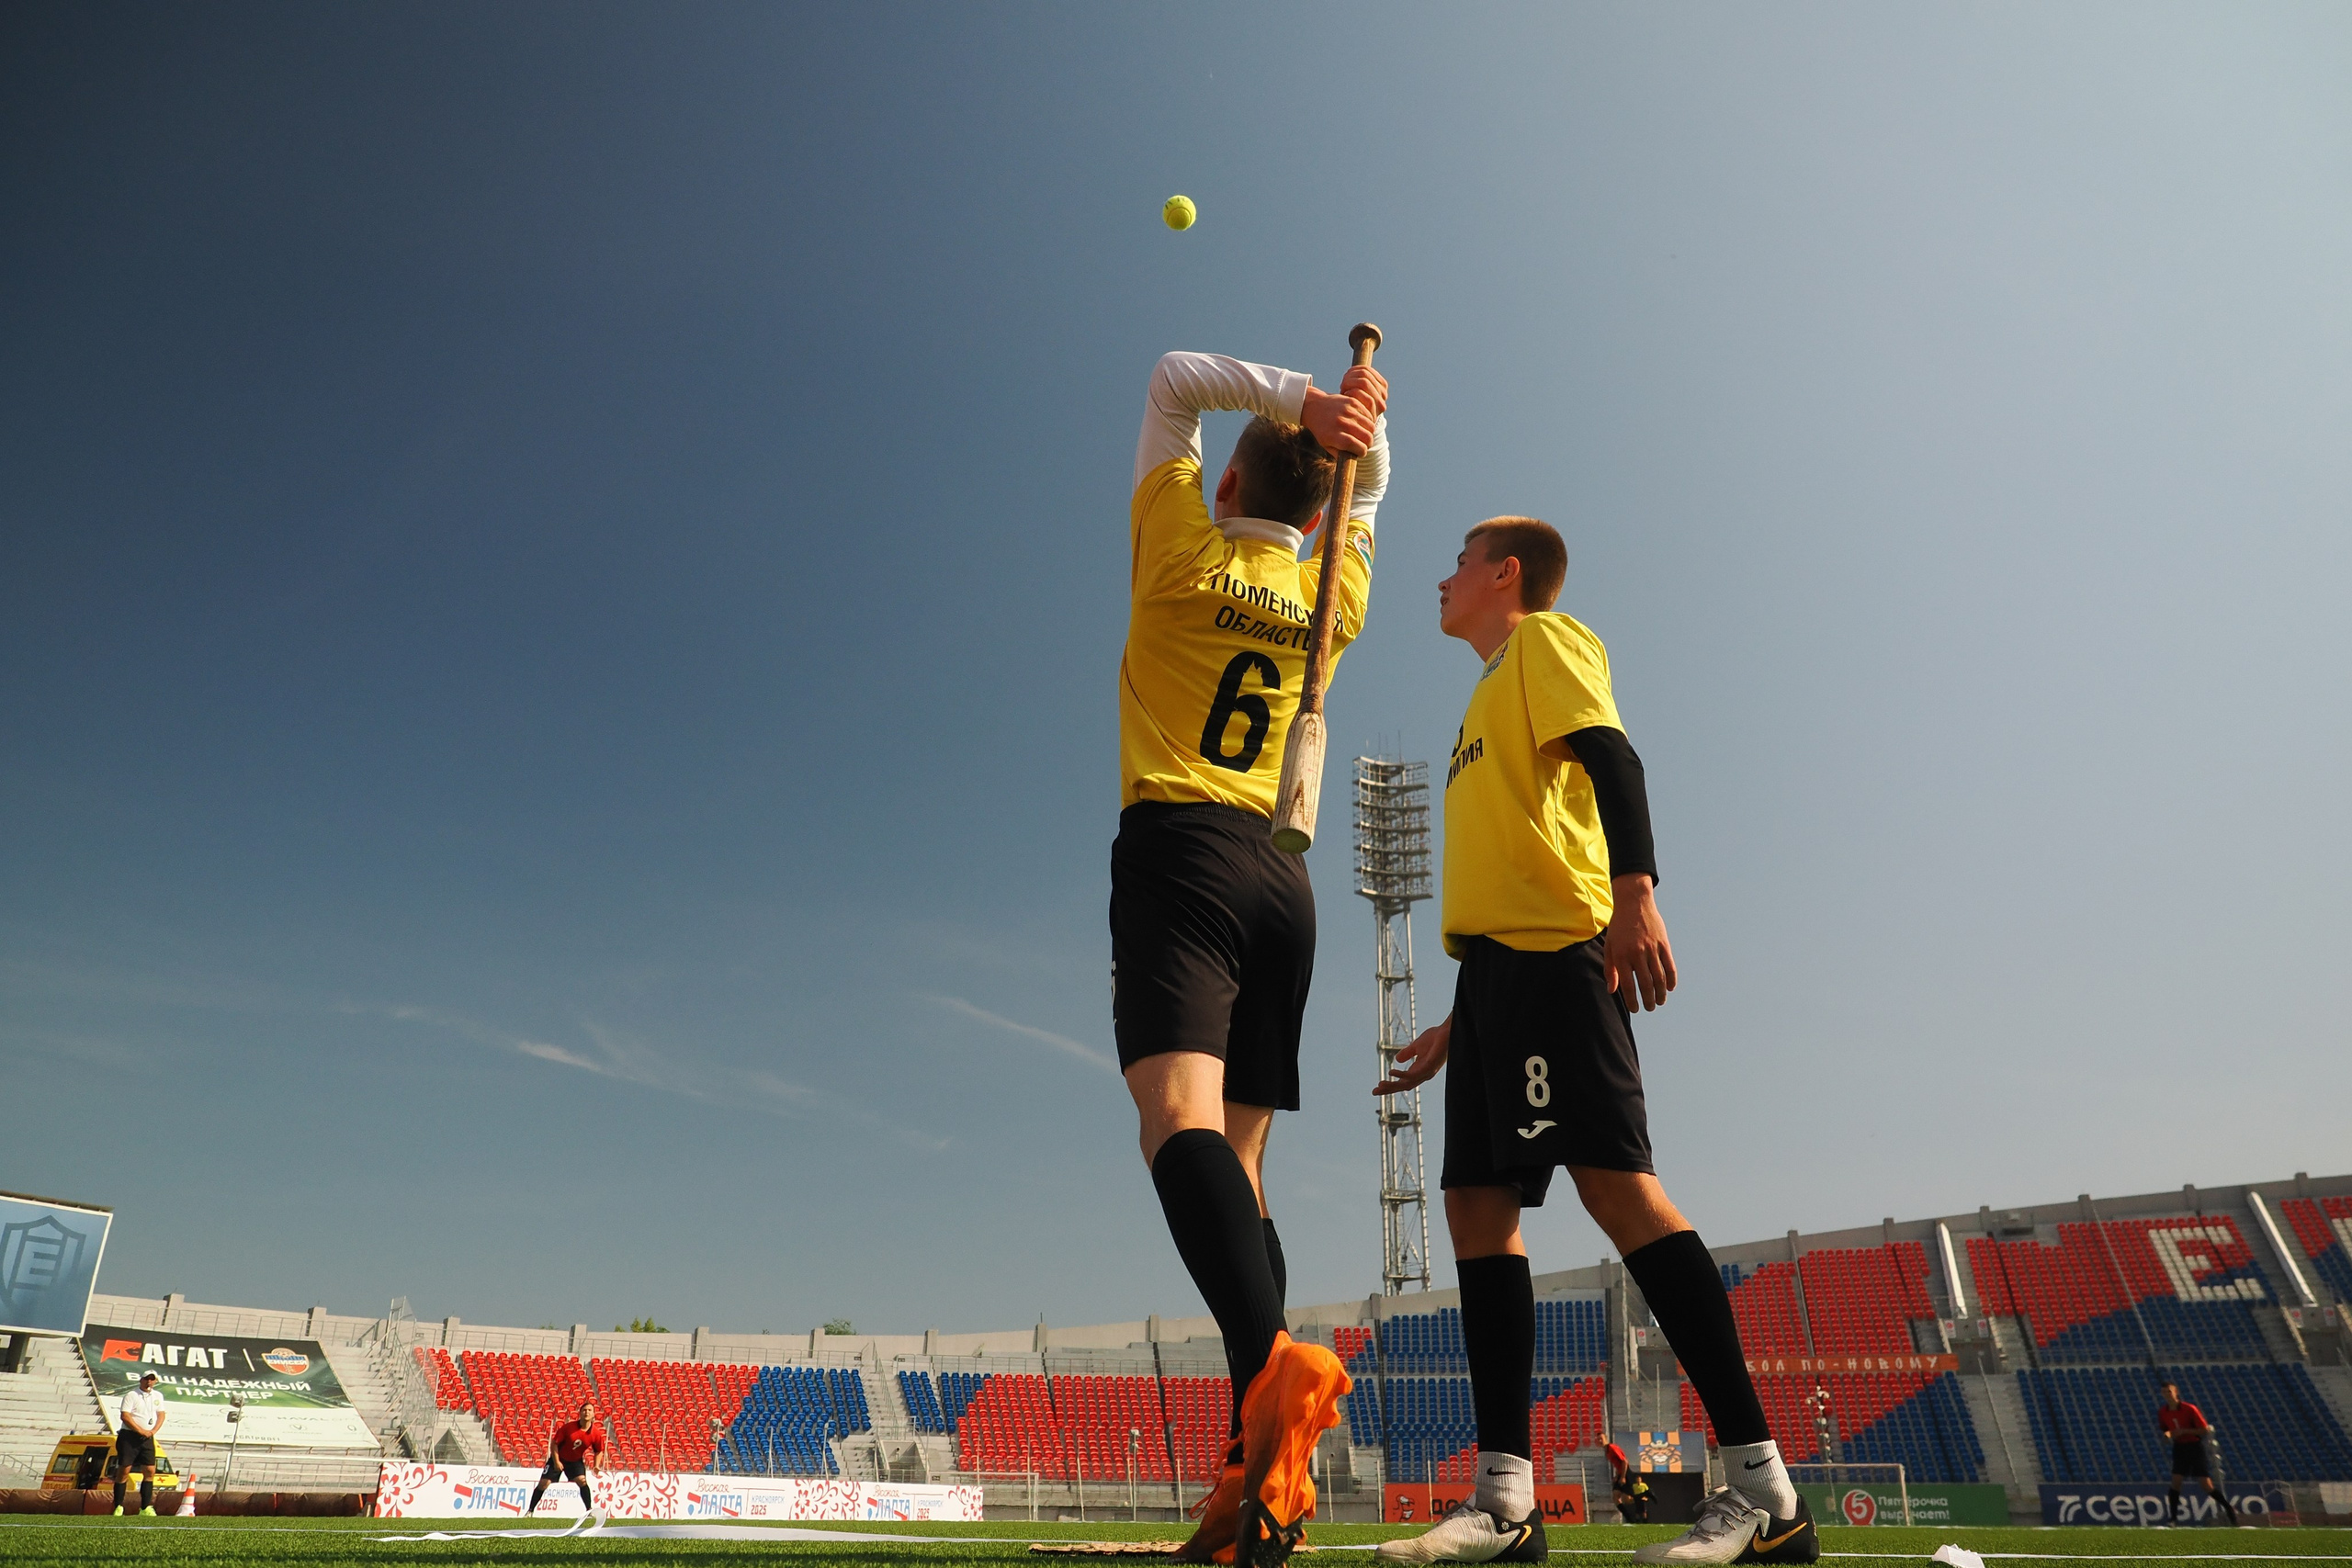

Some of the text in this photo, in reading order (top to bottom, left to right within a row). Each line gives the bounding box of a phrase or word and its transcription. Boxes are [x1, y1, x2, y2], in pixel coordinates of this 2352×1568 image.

[1200, 650, 1282, 773] 6
[1525, 1055, 1551, 1108] 8
[141, 1342, 228, 1369] АГАТ
[1745, 1359, 1785, 1372] БОЛ
[126, 1371, 311, 1391] ВШ НАДЕЖНЫЙ
[175, 1386, 274, 1400] ПАРТНЕР
[571, 1438, 583, 1450] 9
[465, 1469, 511, 1484] Русская
[468, 1486, 526, 1510] ЛАПТА
[537, 1499, 558, 1511] 2025
[698, 1494, 742, 1516] ЛАПТА
[751, 1505, 767, 1516] 2025
[876, 1499, 910, 1520] ЛАПТА
